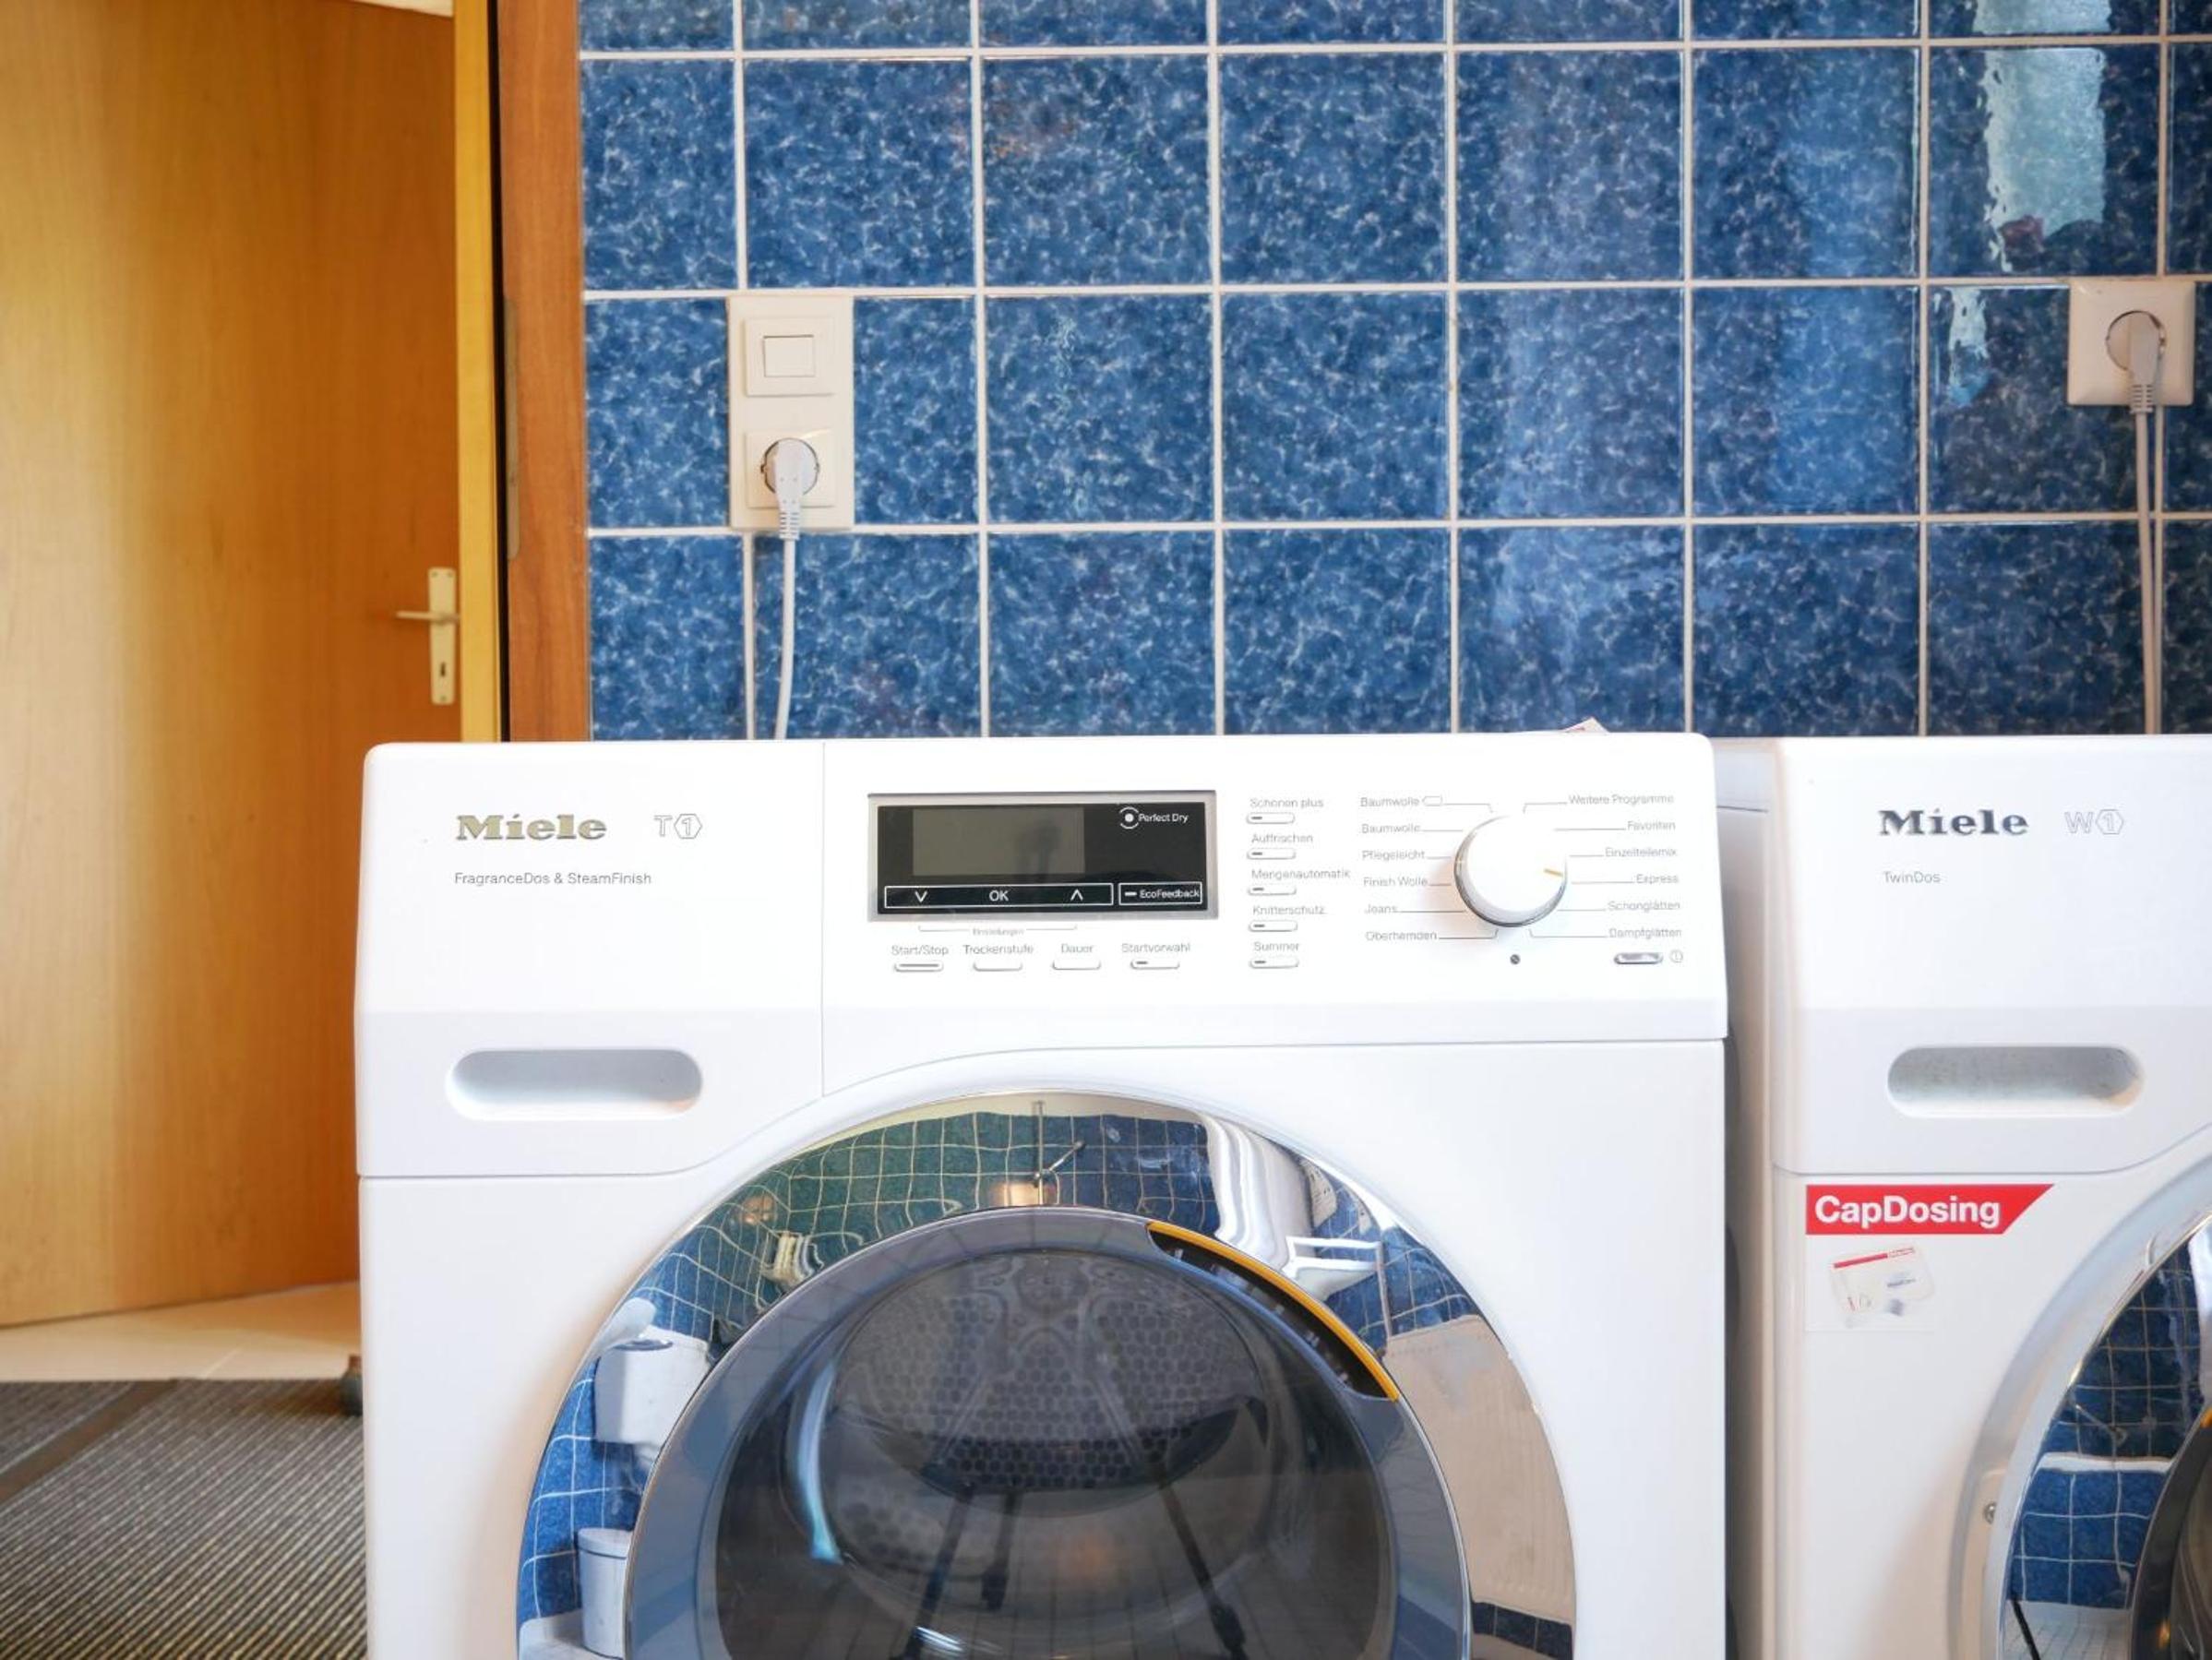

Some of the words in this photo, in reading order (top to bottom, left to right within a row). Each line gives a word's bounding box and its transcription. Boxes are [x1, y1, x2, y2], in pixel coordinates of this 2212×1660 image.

[1249, 797, 1298, 808] Schonen
[1300, 797, 1324, 809] plus
[1360, 796, 1419, 807] Baumwolle
[1569, 794, 1609, 805] Weitere
[1612, 794, 1674, 807] Programme
[1138, 812, 1169, 823] Perfect
[1171, 812, 1189, 824] Dry
[1878, 808, 2028, 836] Miele
[456, 814, 607, 841] Miele
[1361, 823, 1420, 834] Baumwolle
[1627, 820, 1676, 830] Favoriten
[1251, 832, 1313, 844] Auffrischen
[1361, 849, 1425, 862] Pflegeleicht
[454, 872, 551, 887] FragranceDos
[554, 873, 563, 885] &
[568, 872, 652, 885] SteamFinish
[1251, 869, 1351, 881] Mengenautomatik
[1636, 874, 1679, 885] Express
[1883, 871, 1941, 883] TwinDos
[1363, 876, 1395, 888] Finish
[1397, 876, 1429, 887] Wolle
[988, 889, 1010, 903] OK
[1139, 888, 1201, 900] EcoFeedback
[1252, 905, 1325, 916] Knitterschutz
[1365, 903, 1398, 915] Jeans
[1608, 900, 1680, 913] Schonglätten
[1366, 930, 1438, 942] Oberhemden
[1609, 927, 1682, 939] Dampfglätten
[891, 944, 950, 958] Start/Stop
[963, 943, 1034, 956] Trockenstufe
[1060, 943, 1094, 955] Dauer
[1121, 942, 1191, 954] Startvorwahl
[1253, 941, 1299, 953] Summer
[1814, 1195, 2001, 1228] CapDosing
